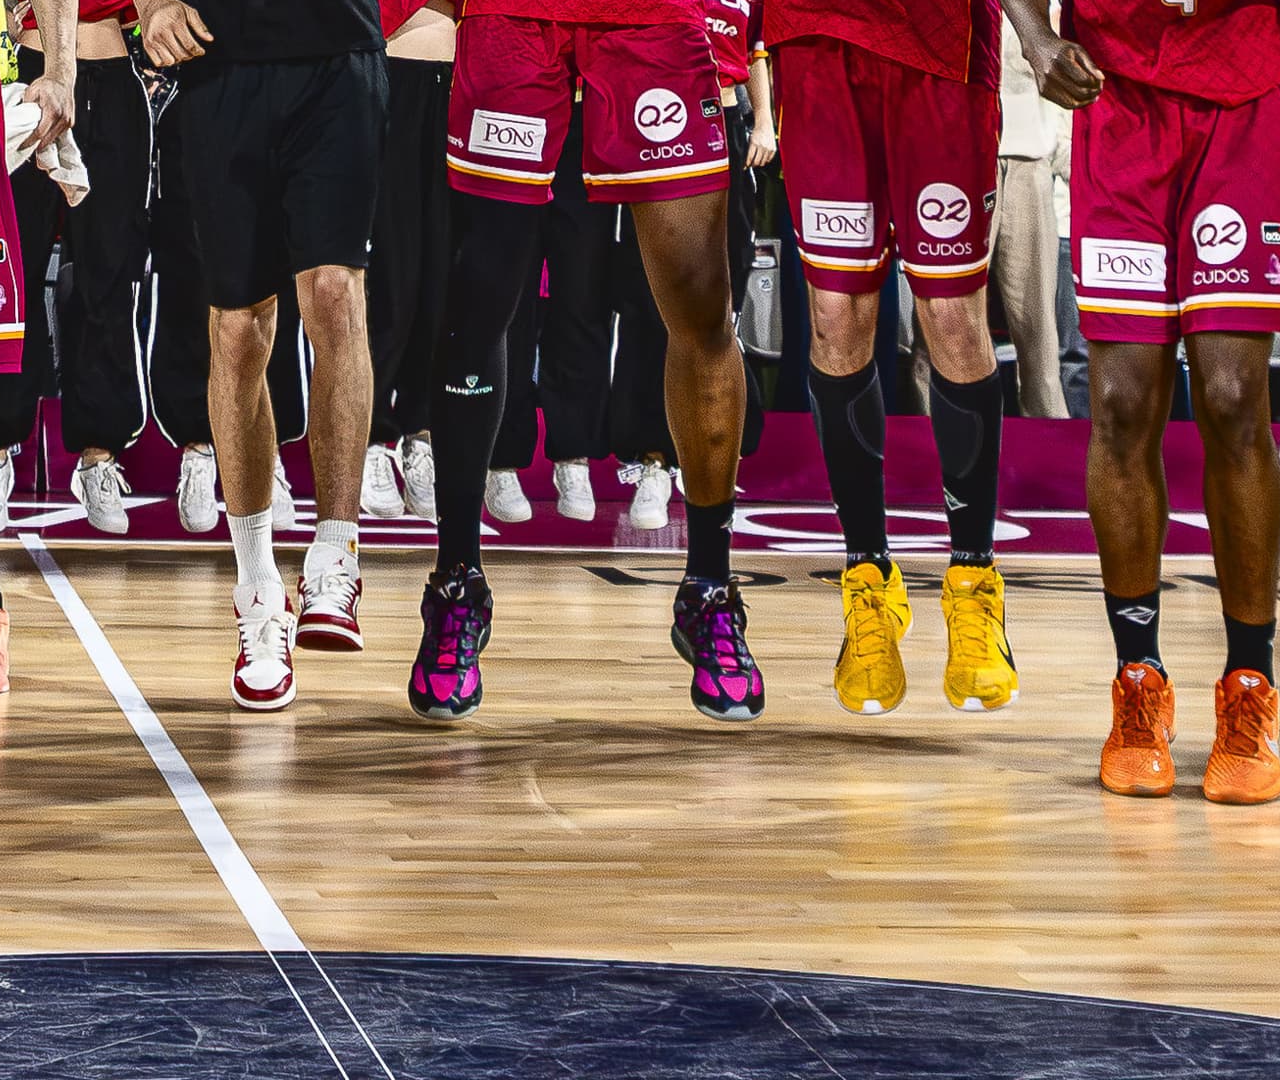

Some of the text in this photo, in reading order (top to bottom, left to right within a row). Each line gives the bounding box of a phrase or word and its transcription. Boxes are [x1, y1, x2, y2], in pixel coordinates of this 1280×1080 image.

[637, 101, 684, 128] Q2
[484, 122, 536, 148] PONS
[920, 198, 969, 222] Q2
[814, 211, 868, 235] PONS
[1196, 220, 1242, 247] Q2
[1097, 252, 1154, 277] PONS
